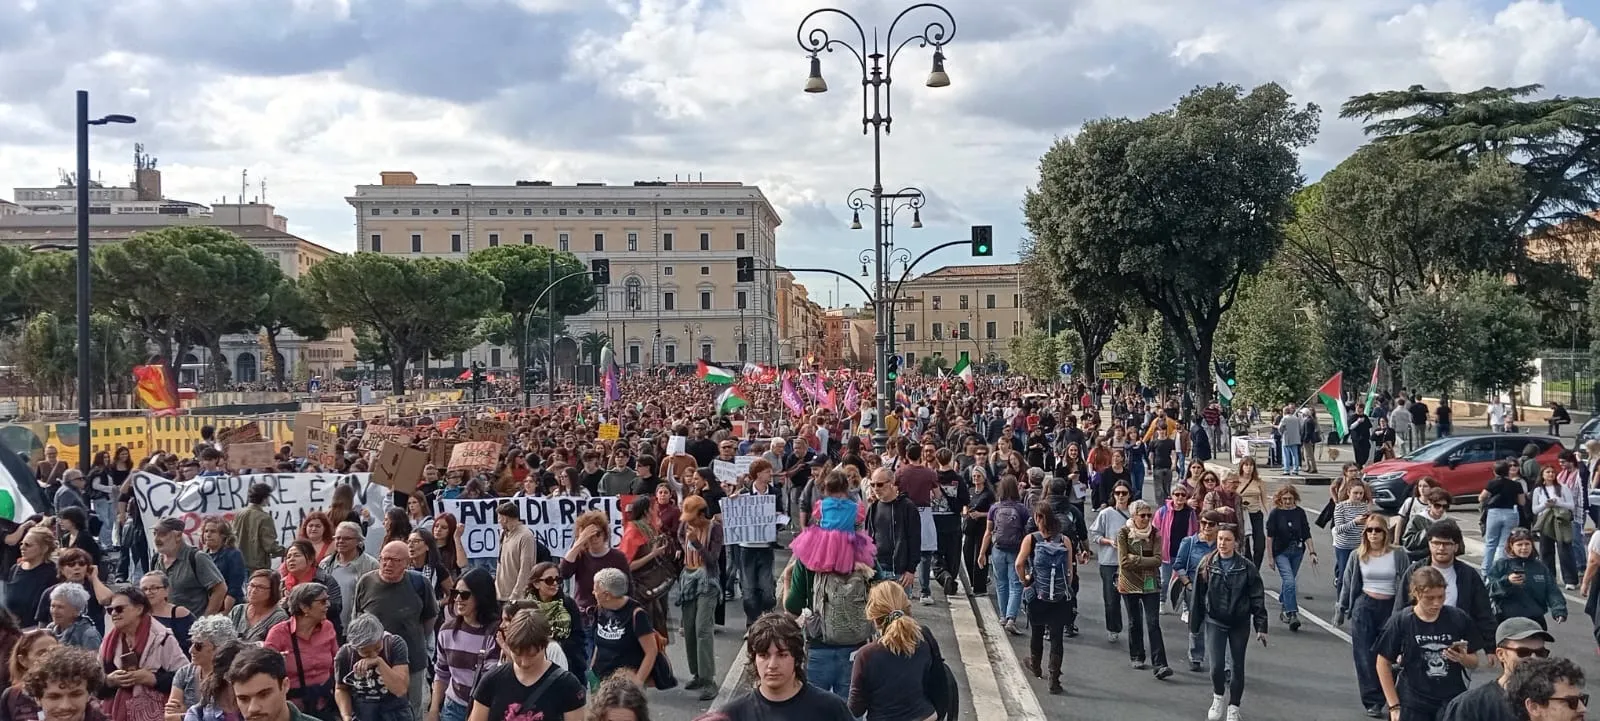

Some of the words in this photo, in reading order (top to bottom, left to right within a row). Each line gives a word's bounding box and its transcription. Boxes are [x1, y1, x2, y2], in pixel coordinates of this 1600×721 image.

[133, 473, 297, 516] SCIOPERARE
[334, 473, 373, 506] N
[438, 498, 549, 525] 'AMLDI
[468, 527, 559, 554] GONO
